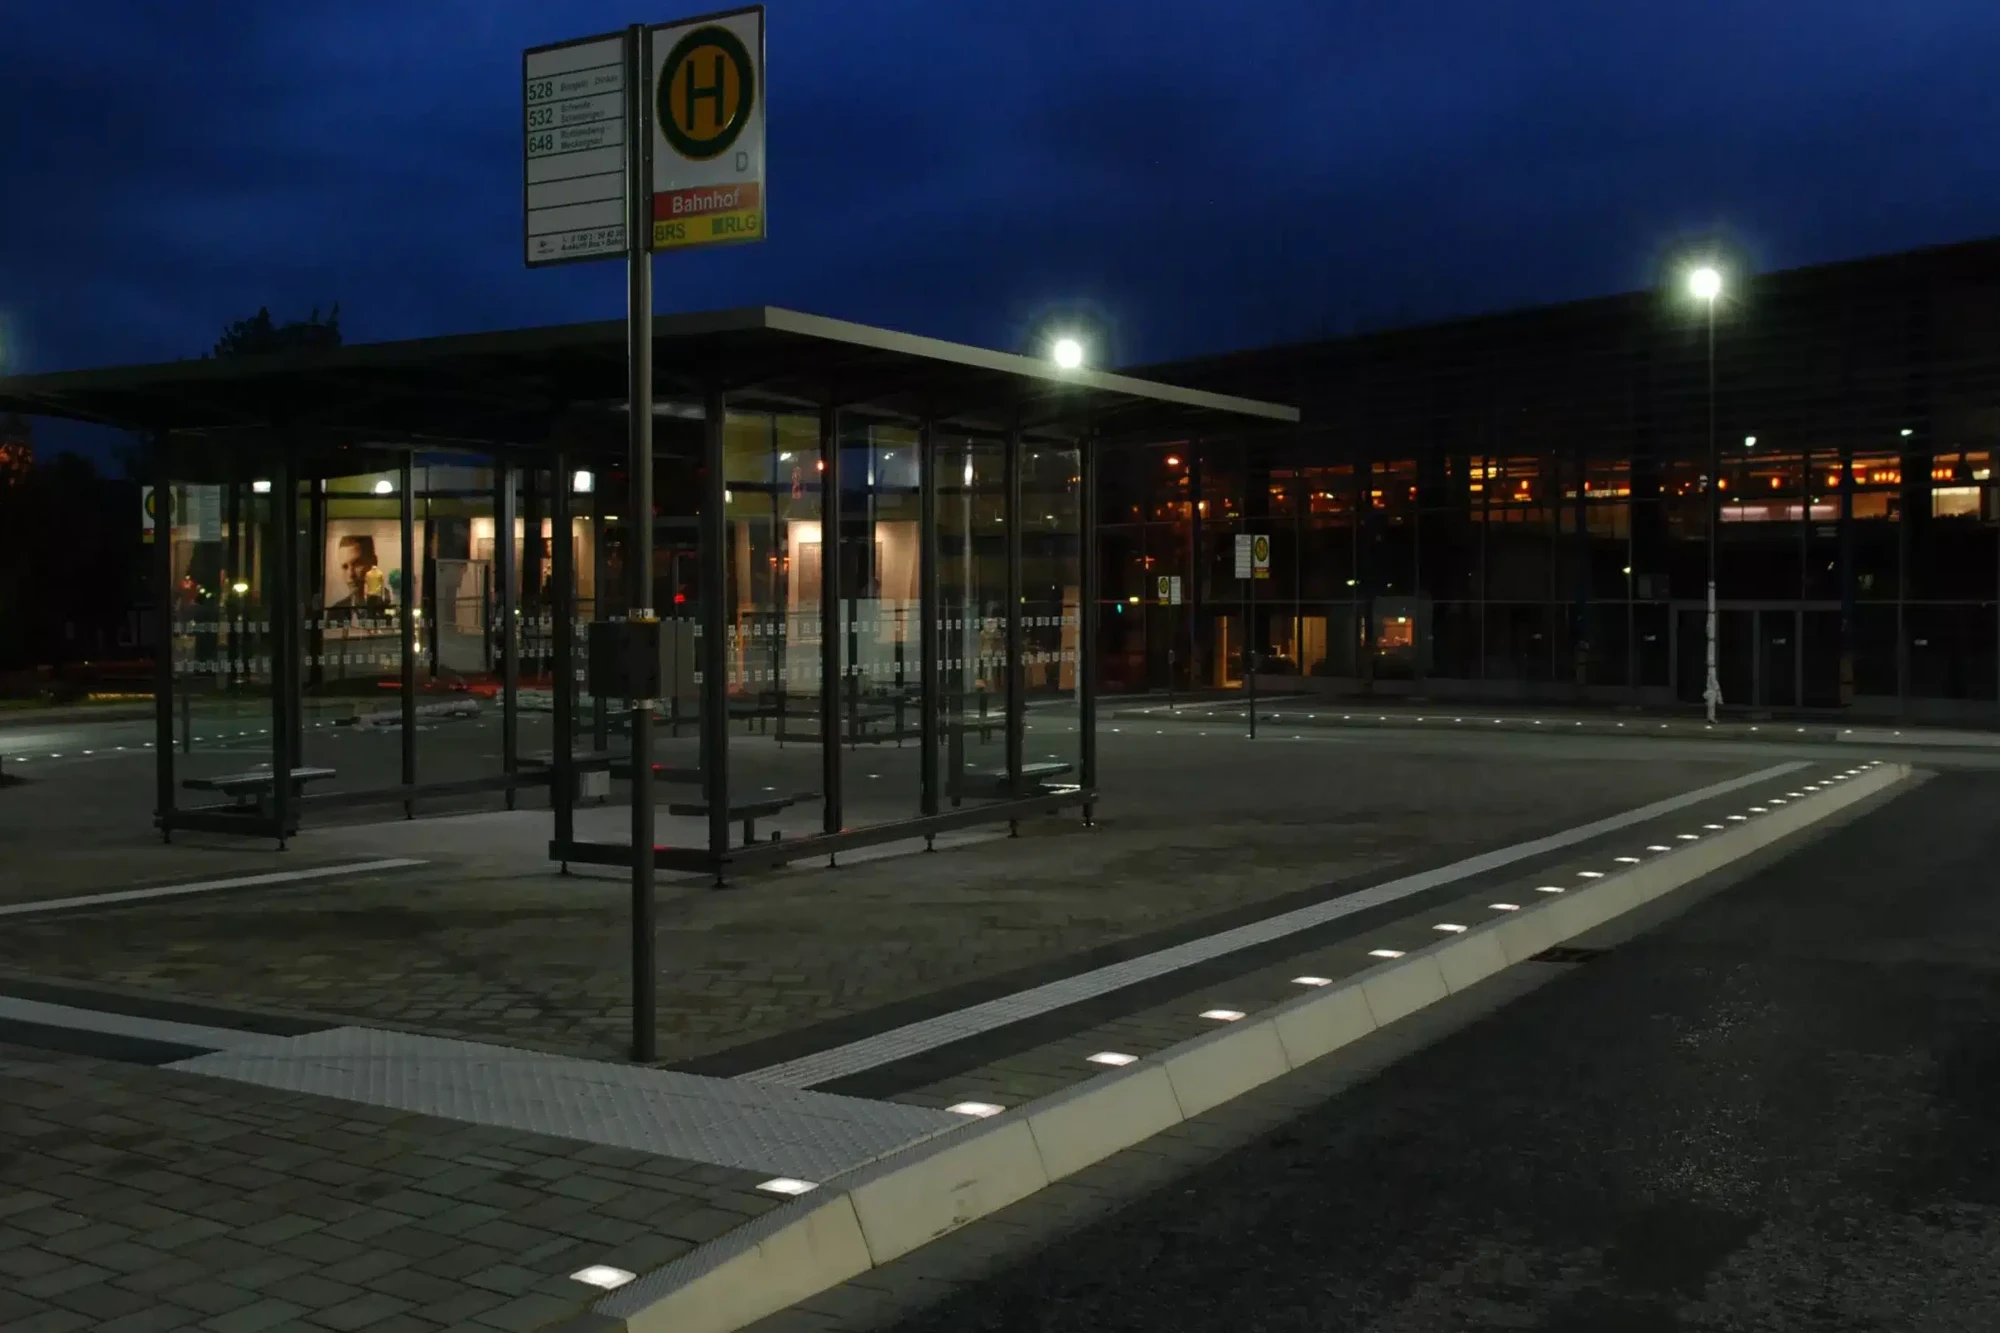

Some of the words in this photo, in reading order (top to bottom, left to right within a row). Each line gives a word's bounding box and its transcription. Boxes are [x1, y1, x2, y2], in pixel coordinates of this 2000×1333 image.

[529, 82, 553, 100] 528
[529, 108, 553, 126] 532
[529, 134, 553, 153] 648
[736, 152, 748, 173] D
[672, 190, 740, 213] Bahnhof
[654, 223, 686, 241] BRS
[726, 214, 757, 233] RLG
